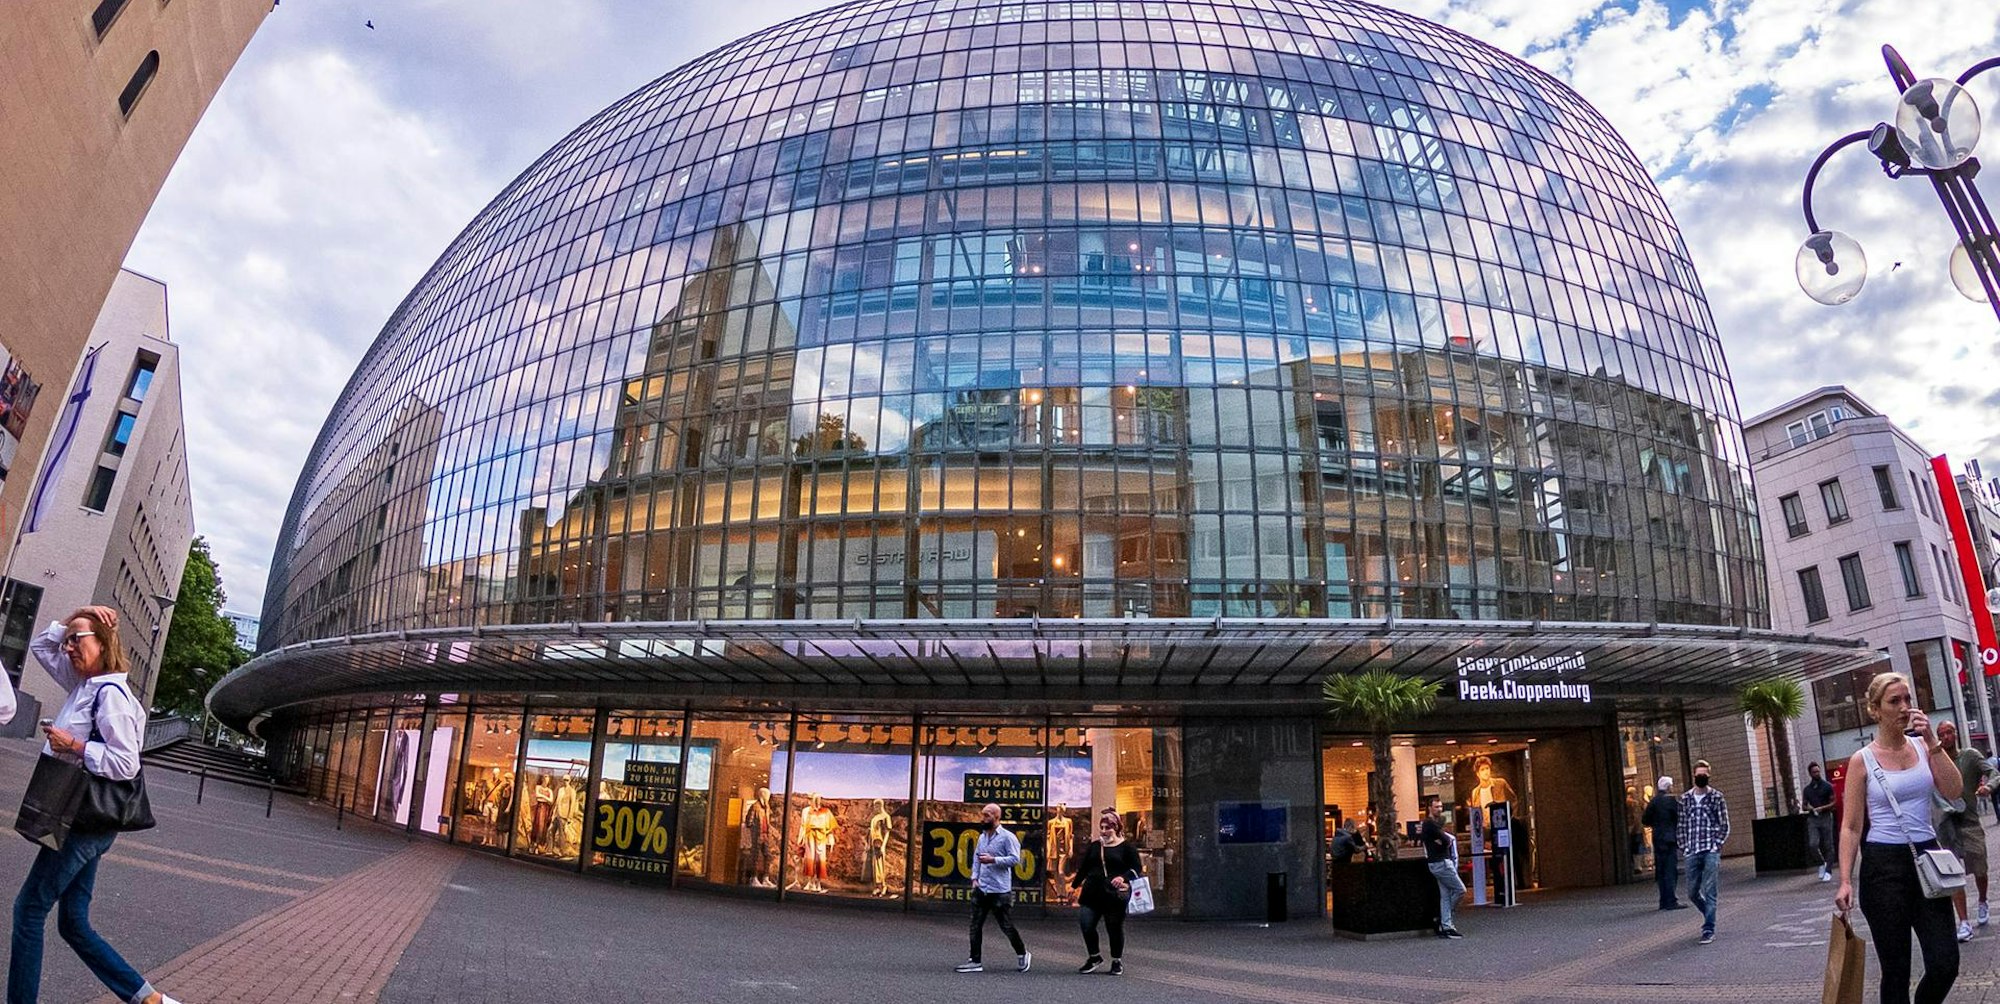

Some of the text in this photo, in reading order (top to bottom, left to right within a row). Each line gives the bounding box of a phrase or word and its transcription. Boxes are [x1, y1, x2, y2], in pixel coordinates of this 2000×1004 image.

[663, 766, 676, 775] SIE
[630, 774, 641, 782] ZU
[1021, 779, 1040, 788] SIE
[638, 789, 675, 802] BIS ZU
[974, 789, 990, 798] ZU
[1021, 809, 1041, 819] ZU
[595, 804, 668, 855] 30%
[605, 856, 668, 874] REDUZIERT
